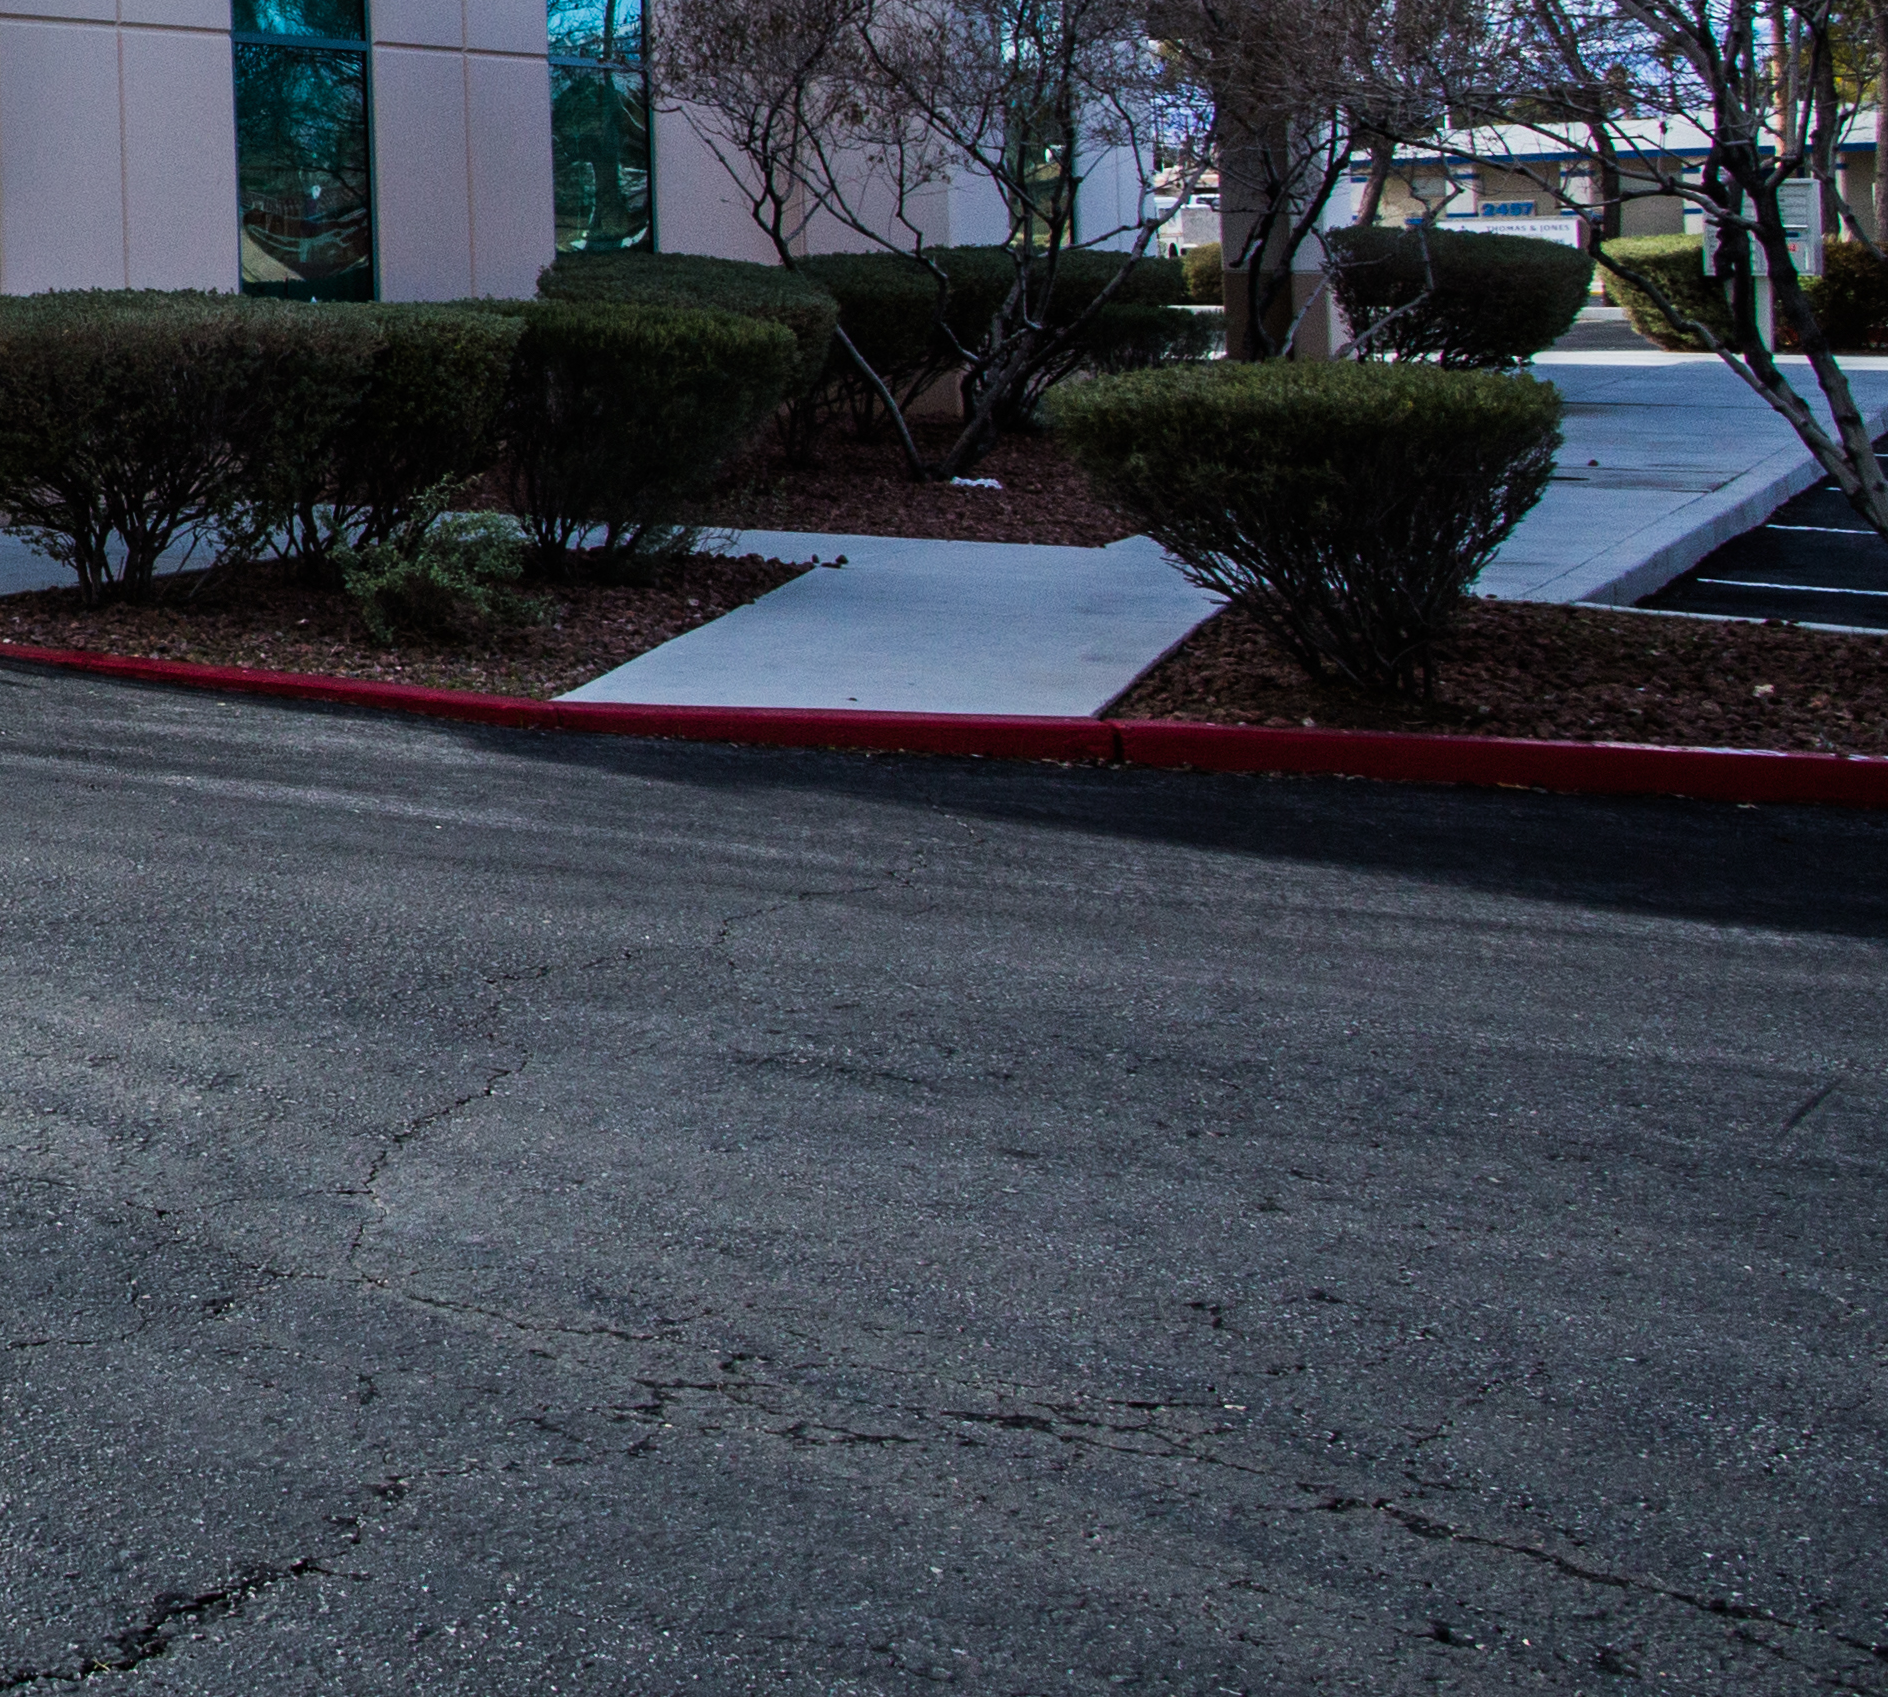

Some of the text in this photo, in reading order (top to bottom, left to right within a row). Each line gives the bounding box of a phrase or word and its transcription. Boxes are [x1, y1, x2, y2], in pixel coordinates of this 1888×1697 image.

[1481, 202, 1534, 217] 2457
[1486, 224, 1570, 233] THOMAS & JONES
